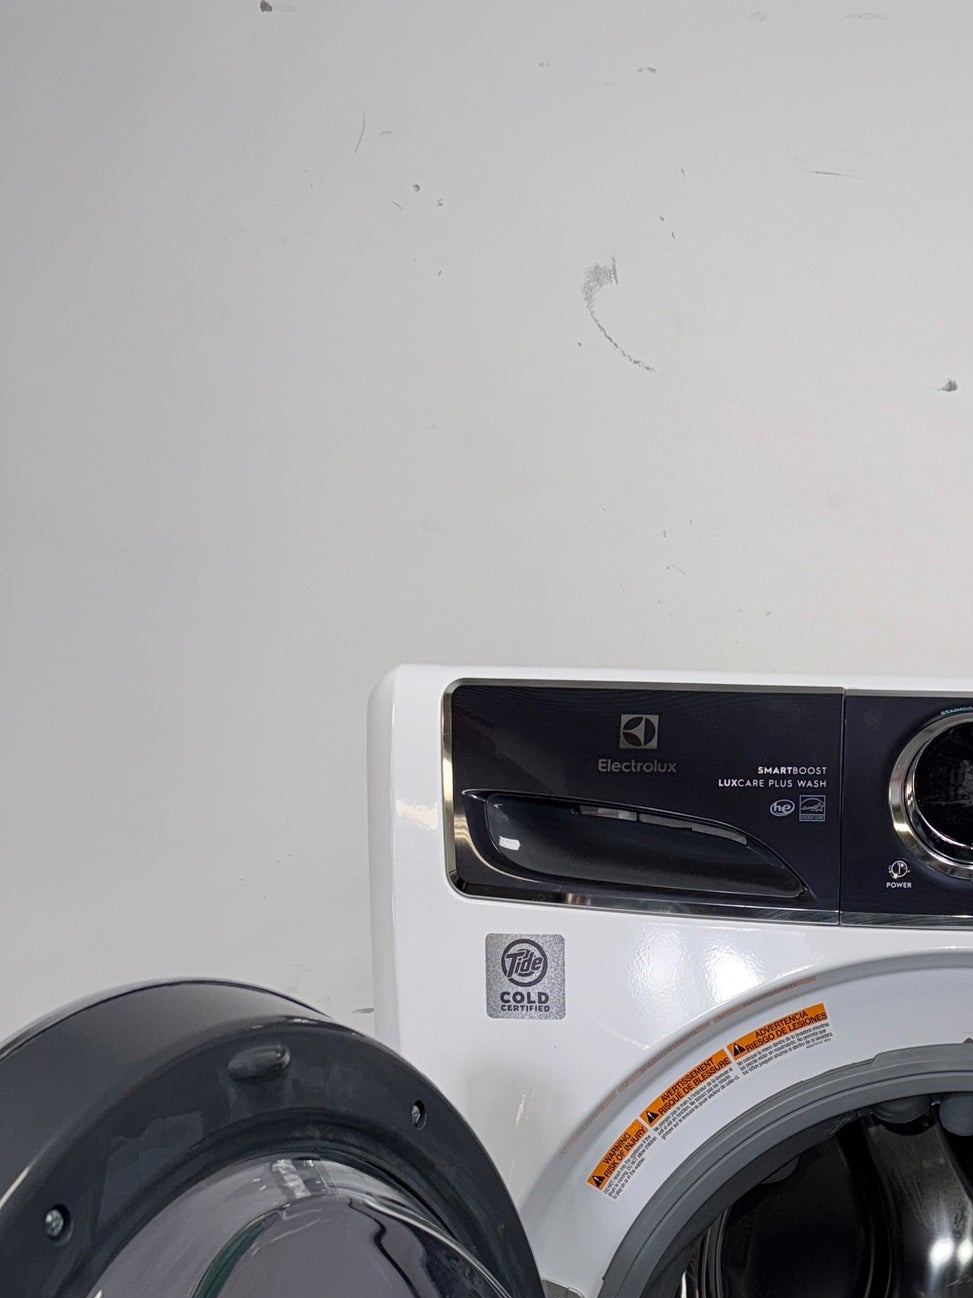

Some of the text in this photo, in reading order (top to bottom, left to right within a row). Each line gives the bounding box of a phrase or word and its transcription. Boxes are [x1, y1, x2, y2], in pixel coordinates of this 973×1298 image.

[598, 758, 677, 773] Electrolux
[757, 766, 827, 775] SMARTBOOST
[718, 779, 827, 788] LUXCARE PLUS WASH
[886, 881, 912, 889] POWER
[505, 948, 543, 979] Tide
[500, 991, 550, 1004] COLD
[501, 1004, 550, 1012] CERTIFIED
[745, 1033, 776, 1051] RIESGO
[775, 1027, 787, 1038] DE
[787, 1012, 827, 1032] LESIONES
[755, 1010, 808, 1038] ADVERTENCIA
[658, 1091, 684, 1115] RISQUE
[682, 1082, 693, 1094] DE
[692, 1057, 731, 1087] BLESSURE
[661, 1058, 715, 1103] AVERTISSEMENT
[603, 1133, 631, 1164] WARNING
[603, 1161, 618, 1177] RISK
[615, 1150, 626, 1161] OF
[624, 1126, 646, 1151] INJURY
